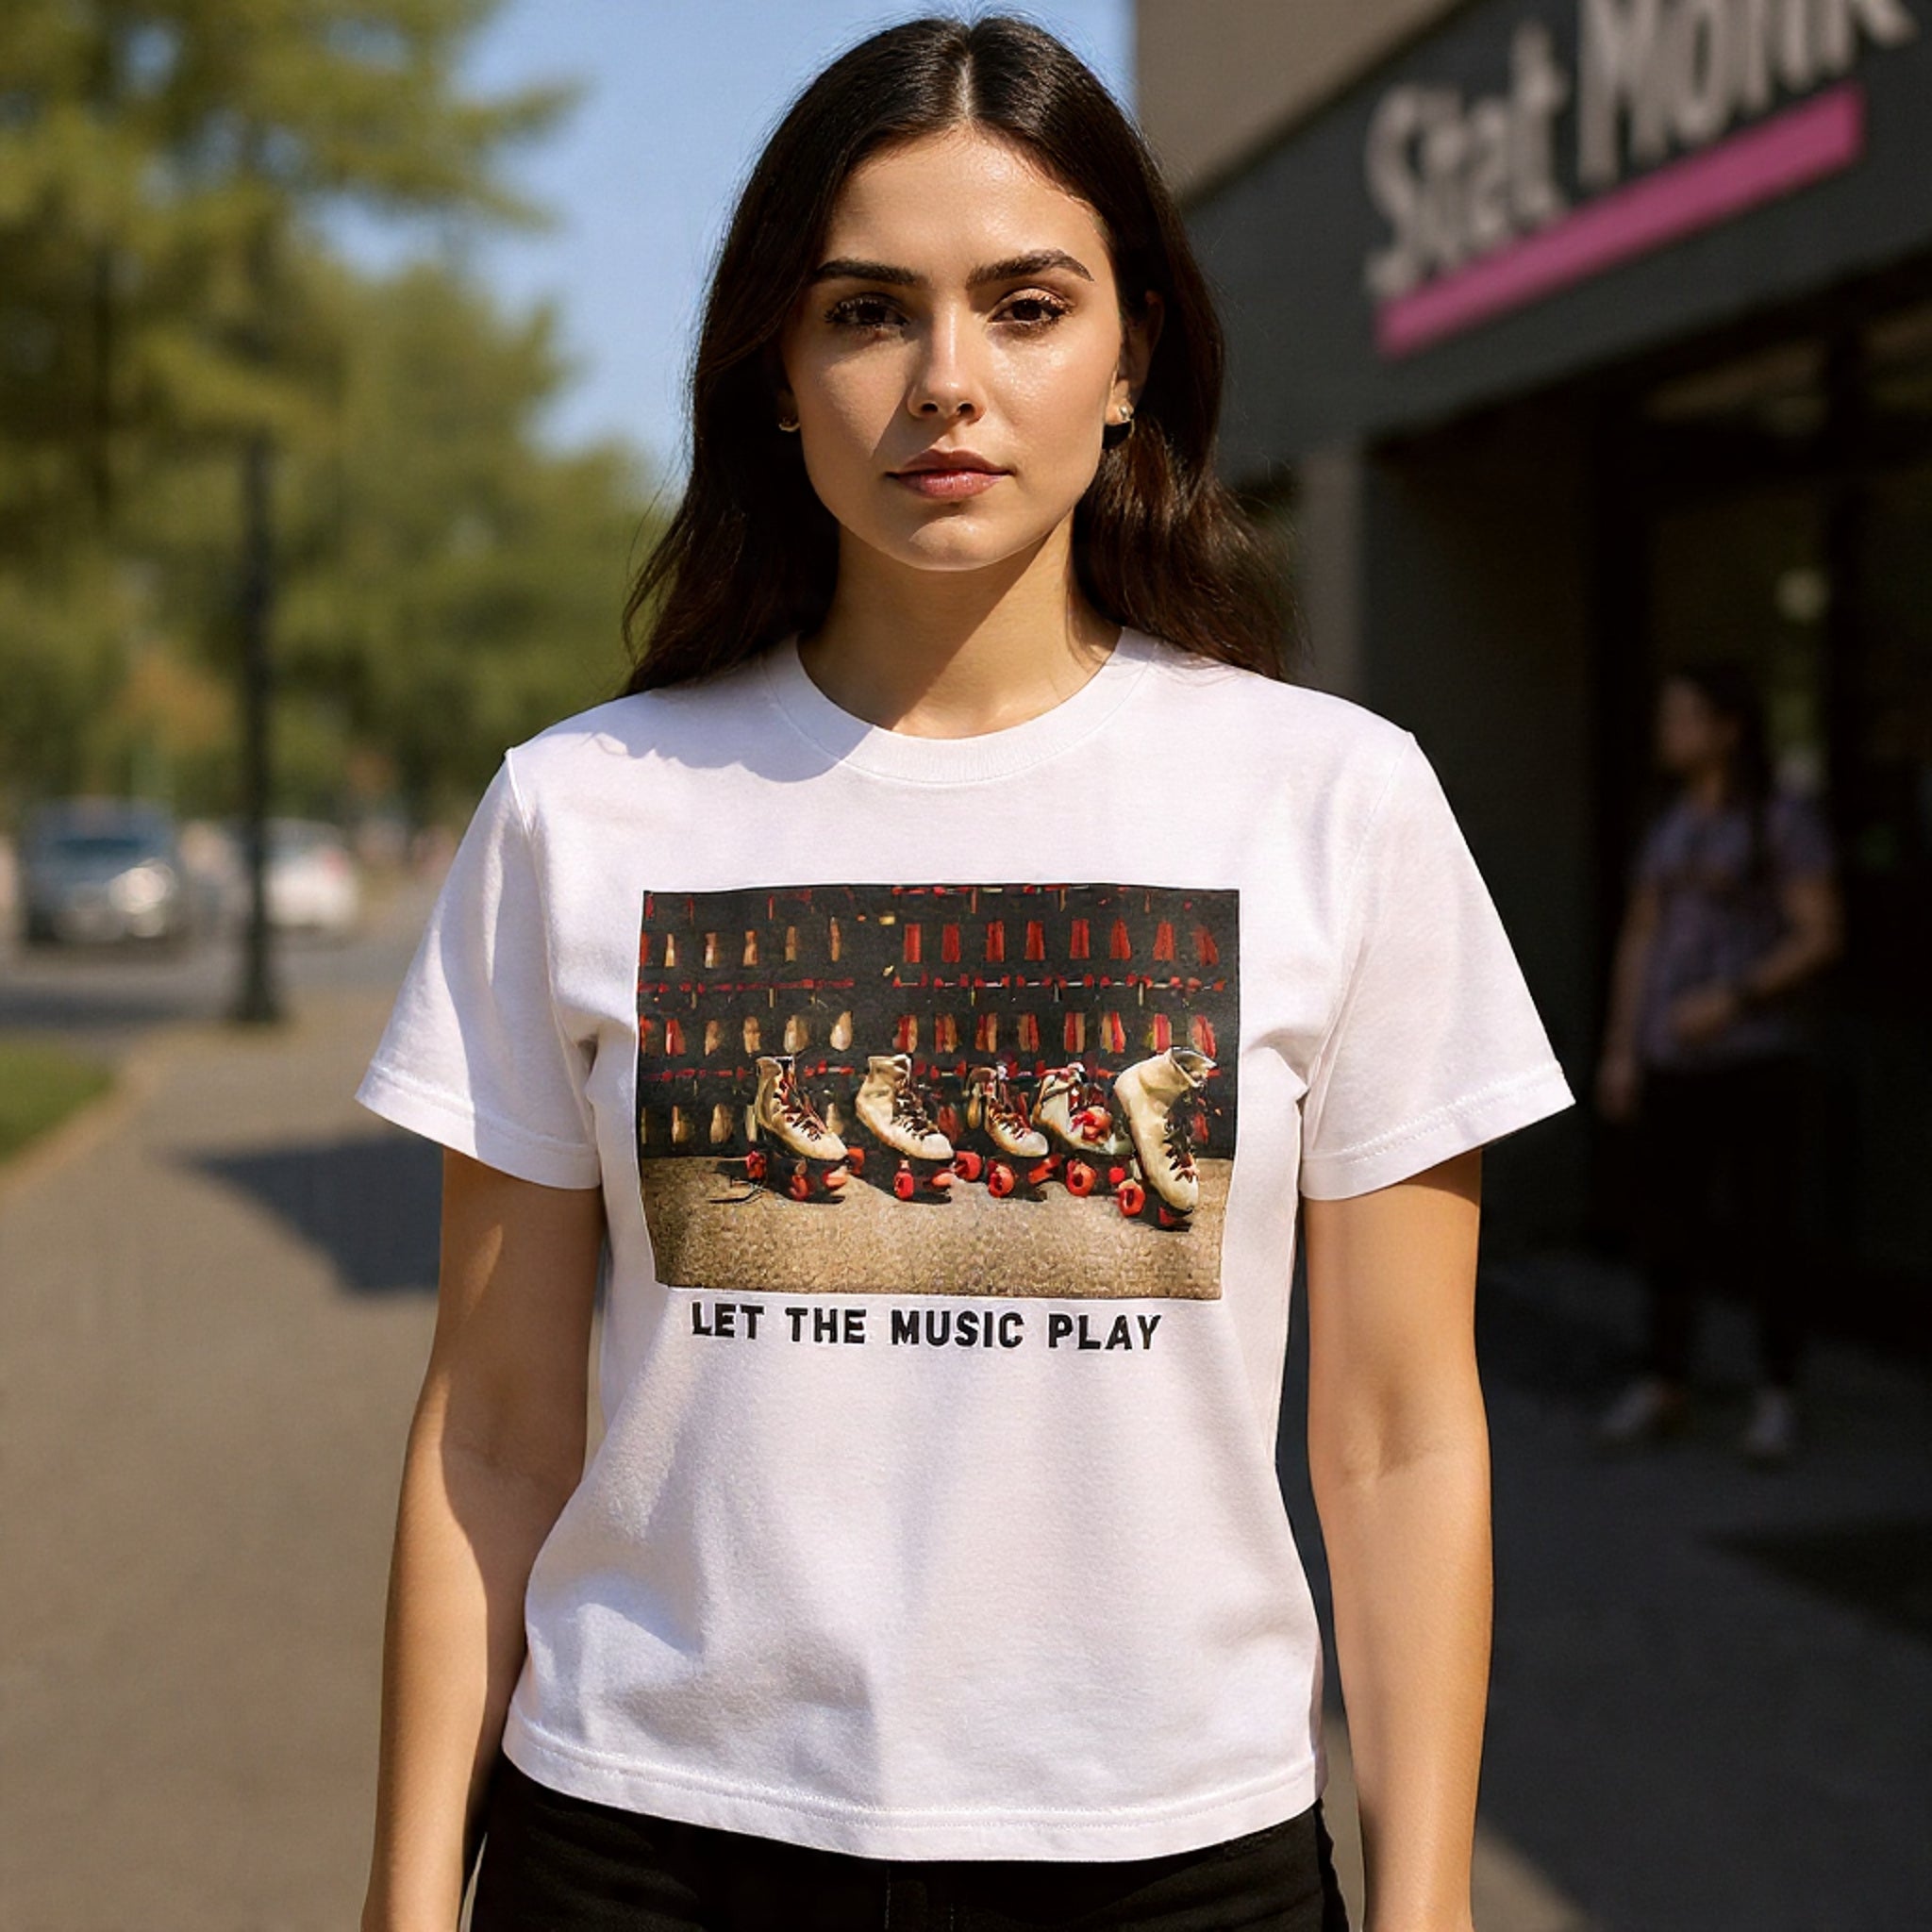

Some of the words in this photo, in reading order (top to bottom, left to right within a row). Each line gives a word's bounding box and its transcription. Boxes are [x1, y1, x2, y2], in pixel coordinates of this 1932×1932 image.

[691, 1301, 765, 1341] LET
[784, 1307, 867, 1344] THE
[891, 1308, 1024, 1349] MUSIC
[1047, 1312, 1162, 1351] PLAY
